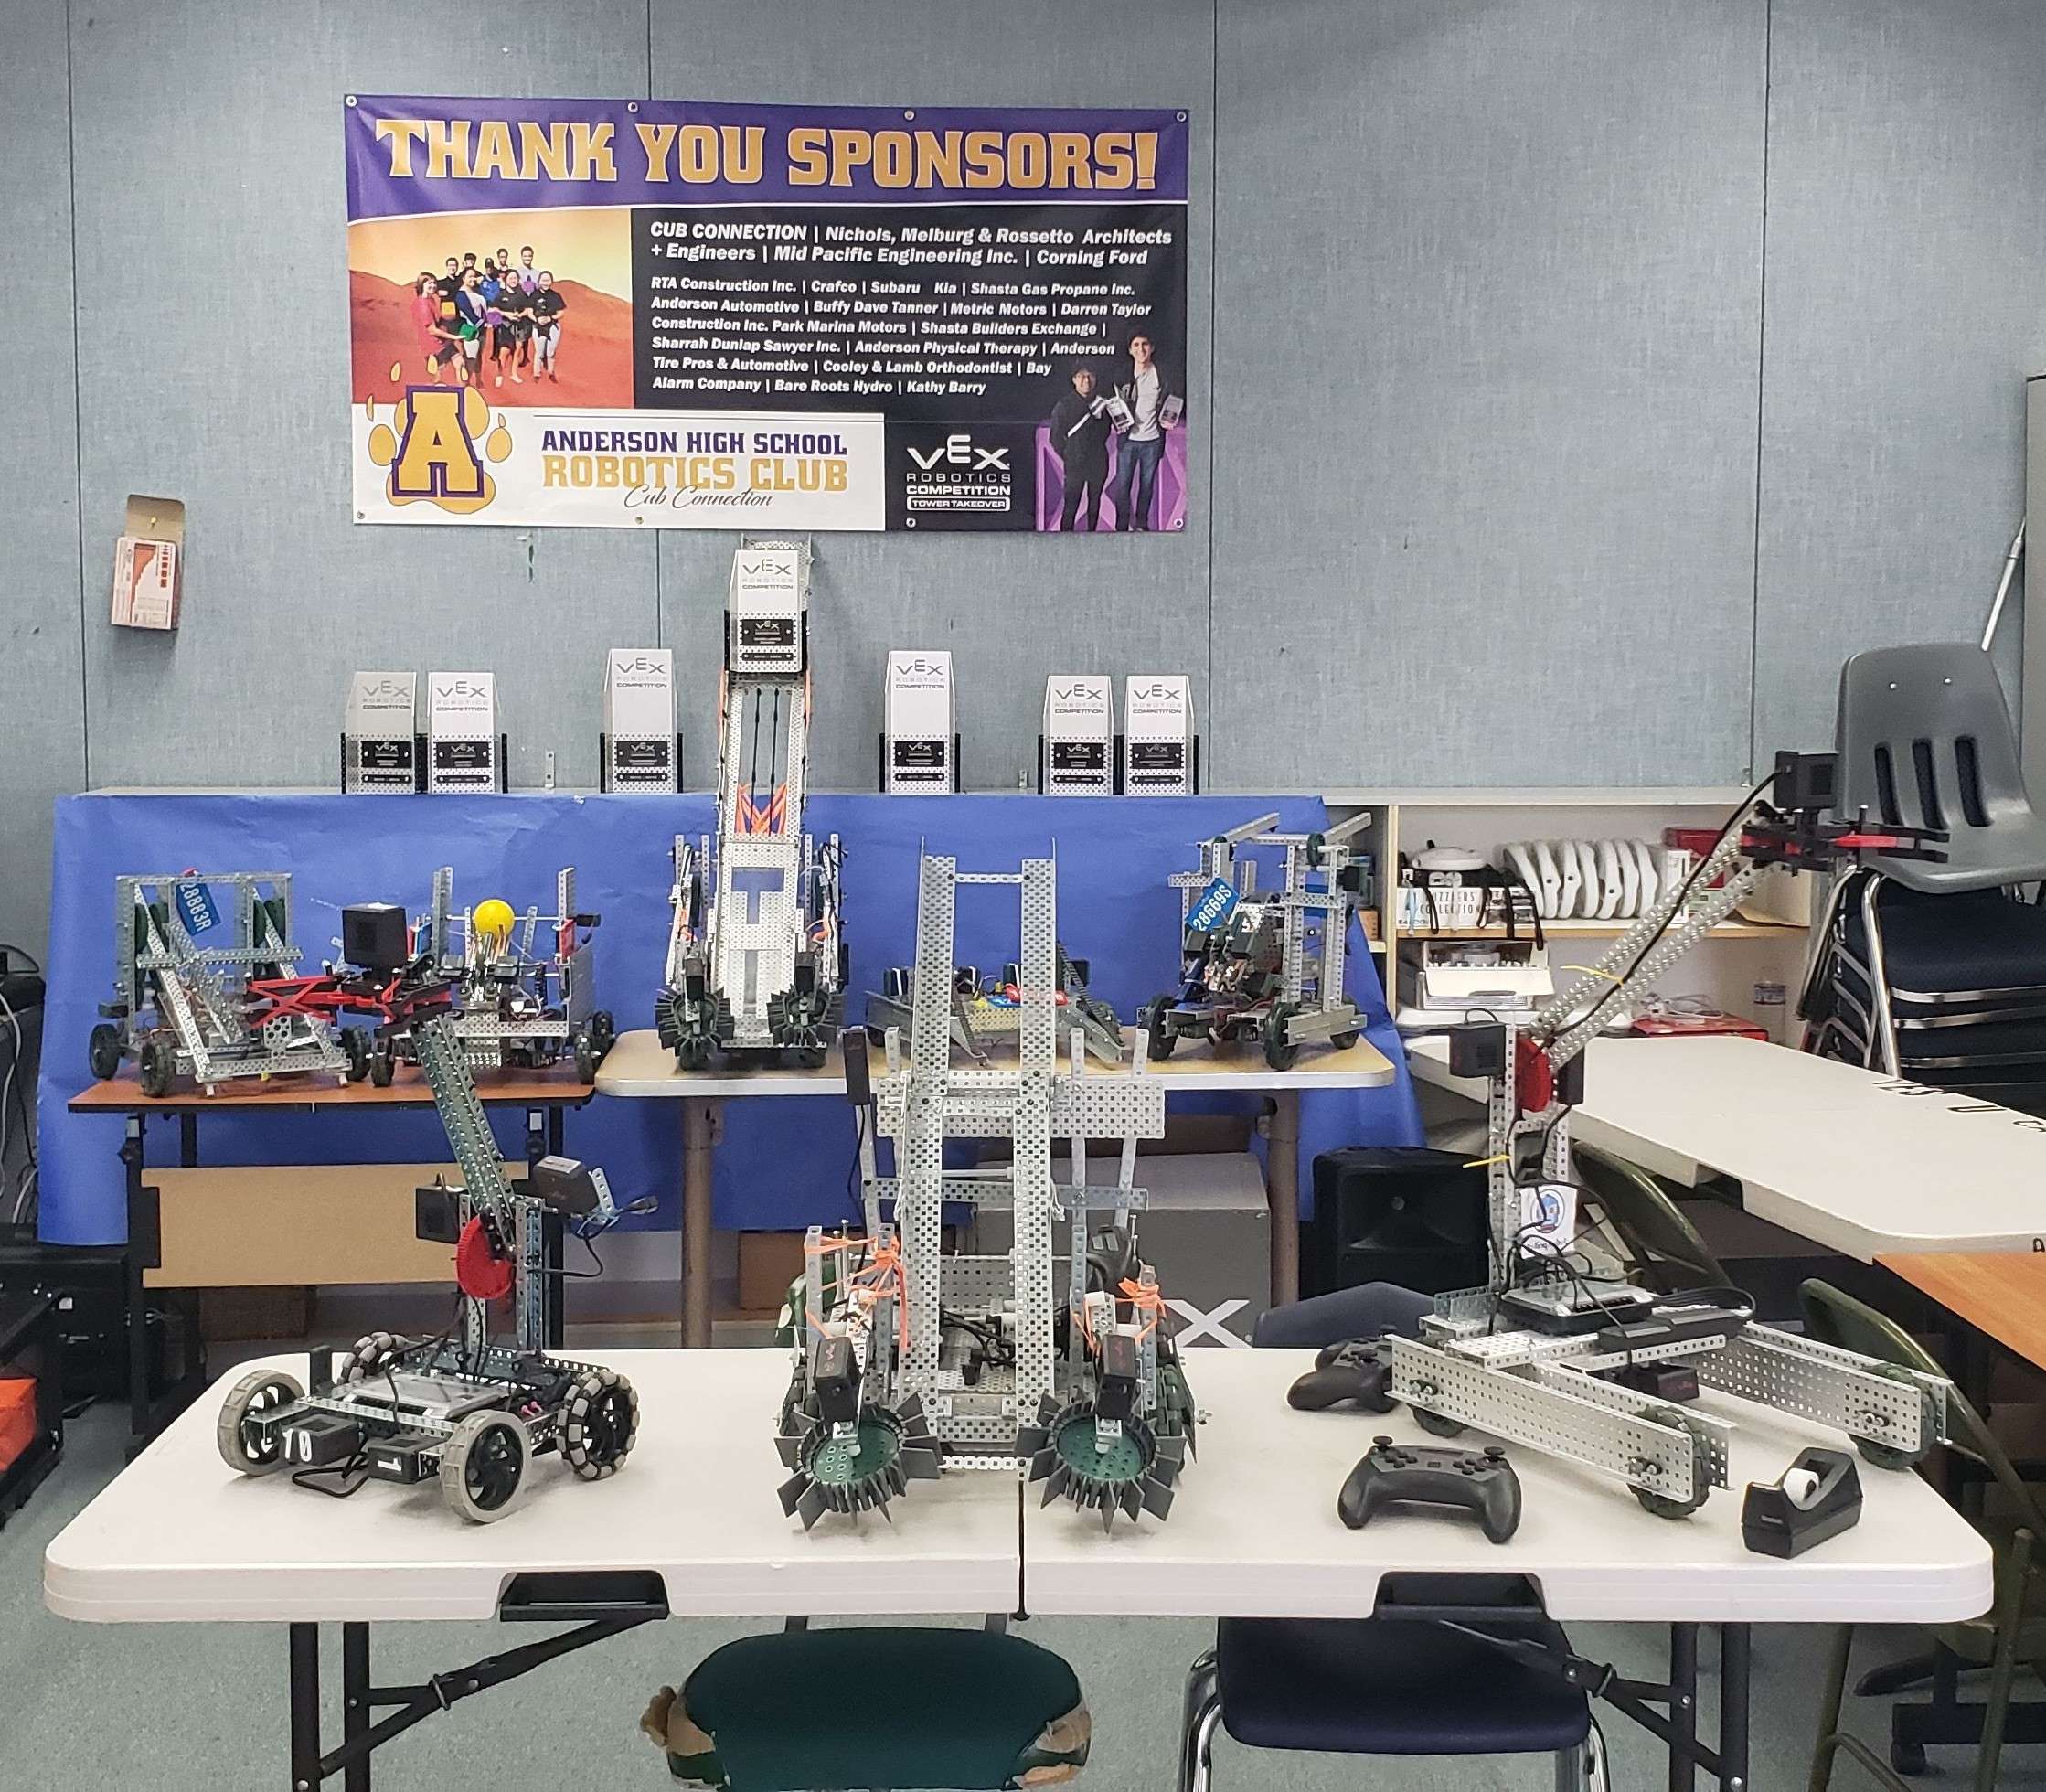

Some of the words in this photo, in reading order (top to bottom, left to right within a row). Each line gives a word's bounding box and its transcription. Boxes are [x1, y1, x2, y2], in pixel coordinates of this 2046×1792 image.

[376, 119, 617, 181] THANK
[635, 123, 765, 183] YOU
[788, 128, 1158, 190] SPONSORS!
[650, 221, 688, 239] CUB
[692, 223, 807, 240] CONNECTION
[826, 226, 896, 245] Nichols,
[901, 228, 975, 246] Melburg
[978, 228, 992, 243] &
[996, 228, 1074, 244] Rossetto
[1082, 229, 1172, 244] Architects
[666, 242, 756, 261] Engineers
[774, 245, 808, 261] Mid
[812, 246, 873, 262] Pacific
[877, 247, 983, 266] Engineering
[986, 248, 1018, 264] Inc.
[1037, 249, 1105, 267] Corning
[1109, 249, 1148, 264] Ford
[651, 276, 677, 289] RTA
[680, 277, 769, 292] Construction
[772, 280, 796, 292] Inc.
[811, 280, 857, 293] Crafco
[870, 281, 921, 293] Subaru
[934, 282, 957, 294] Kia
[971, 283, 1018, 295] Shasta
[1022, 283, 1048, 295] Gas
[1051, 283, 1108, 297] Propane
[1111, 283, 1135, 295] Inc.
[651, 296, 718, 310] Anderson
[720, 299, 800, 313] Automotive
[814, 300, 851, 315] Buffy
[854, 300, 888, 313] Dave
[892, 301, 939, 314] Tanner
[998, 303, 1047, 315] Motors
[1060, 303, 1108, 315] Darren
[1112, 303, 1152, 318] Taylor
[652, 316, 741, 331] Construction
[743, 319, 769, 332] Inc.
[772, 319, 805, 332] Park
[806, 320, 855, 333] Marina
[858, 320, 907, 333] Motors
[921, 321, 968, 334] Shasta
[972, 322, 1028, 335] Builders
[1031, 323, 1097, 336] Exchange
[652, 336, 709, 349] Sharrah
[711, 337, 761, 353] Dunlap
[763, 339, 815, 355] Sawyer
[816, 340, 840, 352] Inc.
[855, 340, 921, 353] Anderson
[923, 341, 981, 356] Physical
[984, 342, 1038, 357] Therapy
[1050, 342, 1115, 355] Anderson
[653, 356, 679, 368] Tire
[682, 357, 714, 369] Pros
[717, 357, 729, 369] &
[730, 357, 809, 372] Automotive
[823, 359, 869, 375] Cooley
[871, 360, 882, 373] &
[886, 360, 923, 373] Lamb
[926, 361, 1012, 374] Orthodontist
[1026, 361, 1052, 376] Bay
[652, 376, 694, 389] Alarm
[697, 377, 762, 393] Company
[810, 379, 850, 392] Roots
[853, 380, 893, 395] Hydro
[907, 380, 946, 395] Kathy
[948, 380, 986, 396] Barry
[391, 386, 485, 497] A
[542, 431, 677, 453] ANDERSON
[687, 432, 744, 453] HIGH
[754, 433, 847, 455] SCHOOL
[907, 434, 1010, 470] VEX
[542, 455, 735, 490] ROBOTICS
[750, 458, 848, 491] CLUB
[907, 474, 1010, 483] ROBOTICS
[624, 485, 667, 508] Cub
[672, 484, 773, 508] Connection
[907, 485, 1010, 496] COMPETITION
[912, 500, 950, 508] TOWER
[951, 500, 1006, 508] TAKEOVER
[742, 559, 791, 574] VEX
[616, 658, 666, 674] VEX
[896, 659, 943, 675] VEX
[363, 681, 410, 697] VEX
[436, 681, 487, 698] VEX
[1055, 684, 1103, 699] VEX
[1134, 684, 1180, 699] VEX
[1193, 885, 1231, 931] 28669S
[282, 1428, 312, 1462] 10
